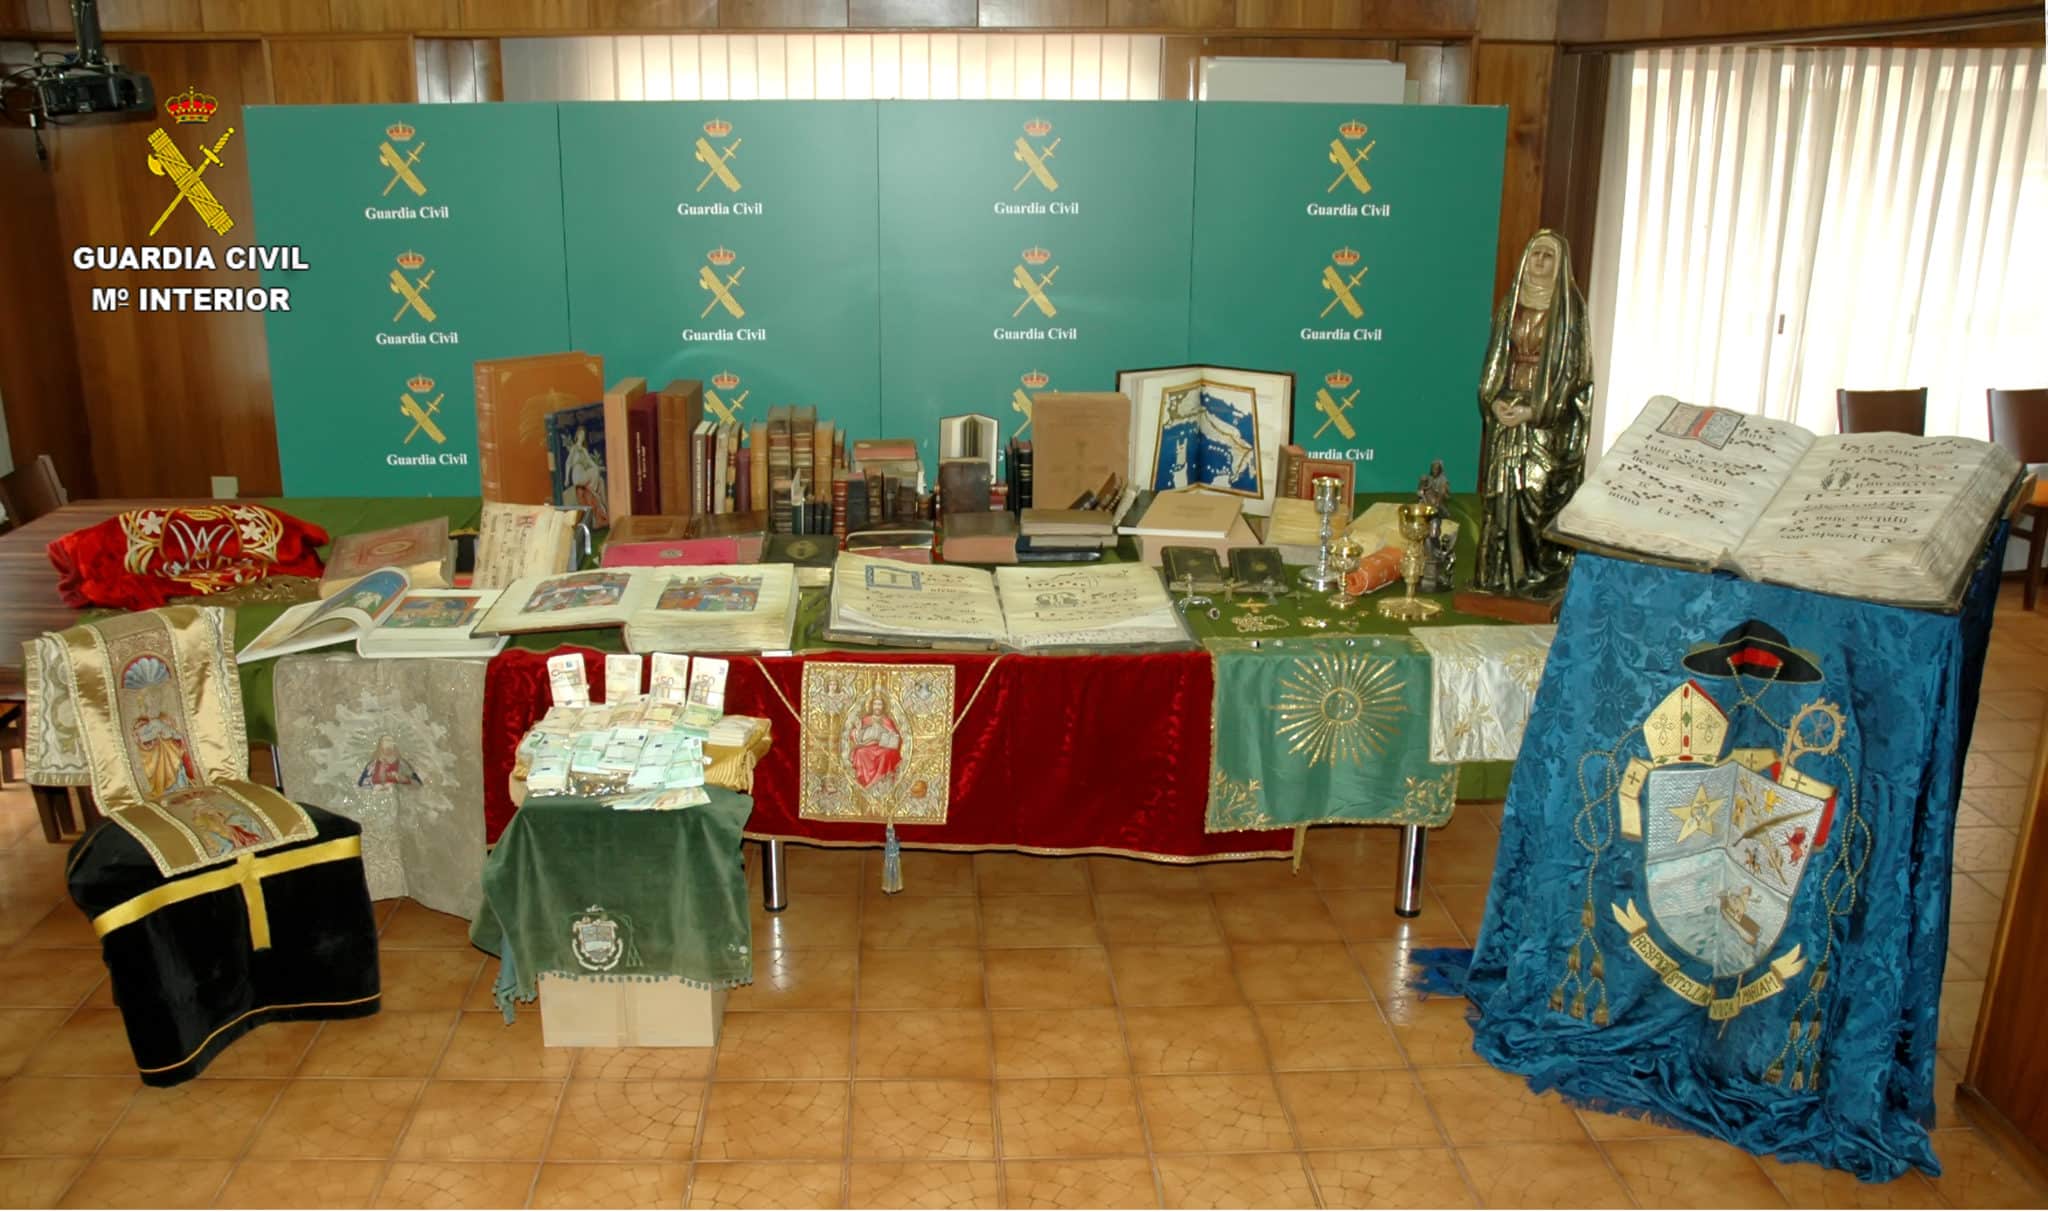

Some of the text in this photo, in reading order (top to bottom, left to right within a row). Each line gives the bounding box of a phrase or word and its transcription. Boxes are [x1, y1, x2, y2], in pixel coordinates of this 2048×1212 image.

[364, 206, 449, 220] Guardia Civil
[676, 201, 763, 216] Guardia Civil
[993, 201, 1080, 216] Guardia Civil
[1306, 203, 1390, 217] Guardia Civil
[375, 332, 458, 345] Guardia Civil
[682, 328, 767, 341] Guardia Civil
[993, 328, 1077, 341] Guardia Civil
[1300, 328, 1382, 341] Guardia Civil
[386, 453, 468, 465] Guardia Civil
[1345, 448, 1374, 460] Civil
